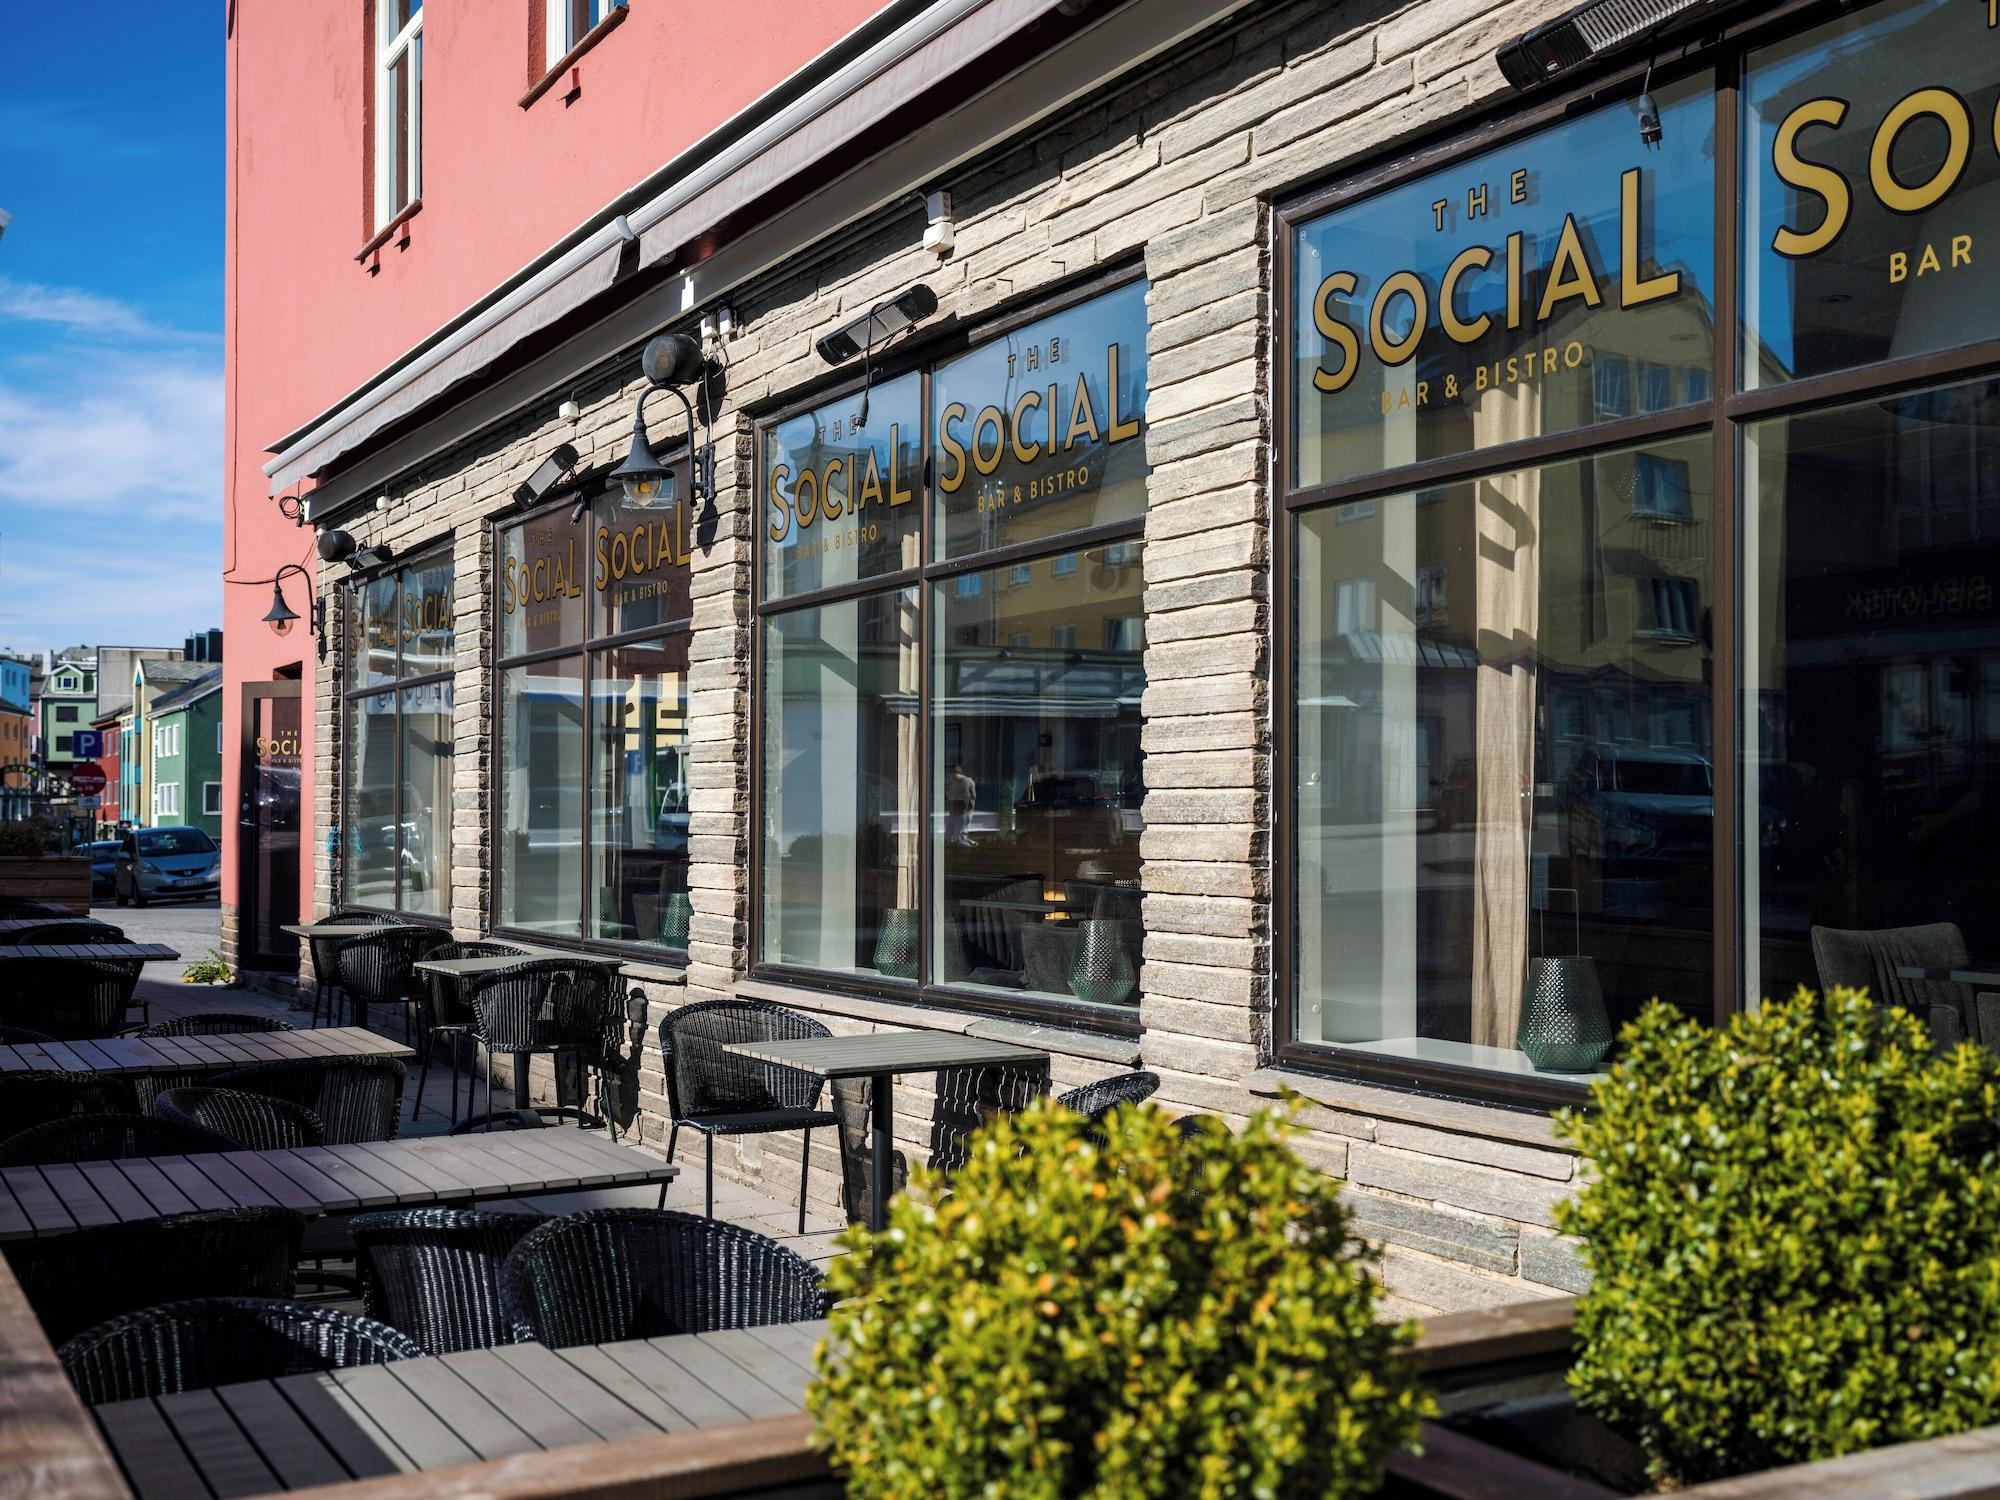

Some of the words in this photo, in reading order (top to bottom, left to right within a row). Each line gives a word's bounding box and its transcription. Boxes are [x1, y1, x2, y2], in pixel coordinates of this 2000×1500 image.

[1432, 168, 1527, 231] THE
[1772, 86, 2000, 260] SO
[1313, 166, 1682, 394] SOCIAL
[1889, 235, 1973, 284] BAR
[1007, 337, 1060, 379] THE
[1381, 381, 1429, 414] BAR
[1444, 374, 1459, 400] &
[1475, 341, 1584, 391] BISTRO
[819, 413, 858, 447] THE
[939, 342, 1141, 494] SOCIAL
[770, 423, 912, 543] SOCIAL
[977, 489, 1006, 513] BAR
[1013, 485, 1022, 504] &
[1030, 466, 1089, 500] BISTRO
[595, 498, 692, 592] SOCIAL
[823, 539, 830, 553] &
[835, 523, 878, 549] BISTRO
[503, 537, 582, 615] SOCIAL
[639, 580, 668, 600] BISTRO
[80, 734, 96, 755] P
